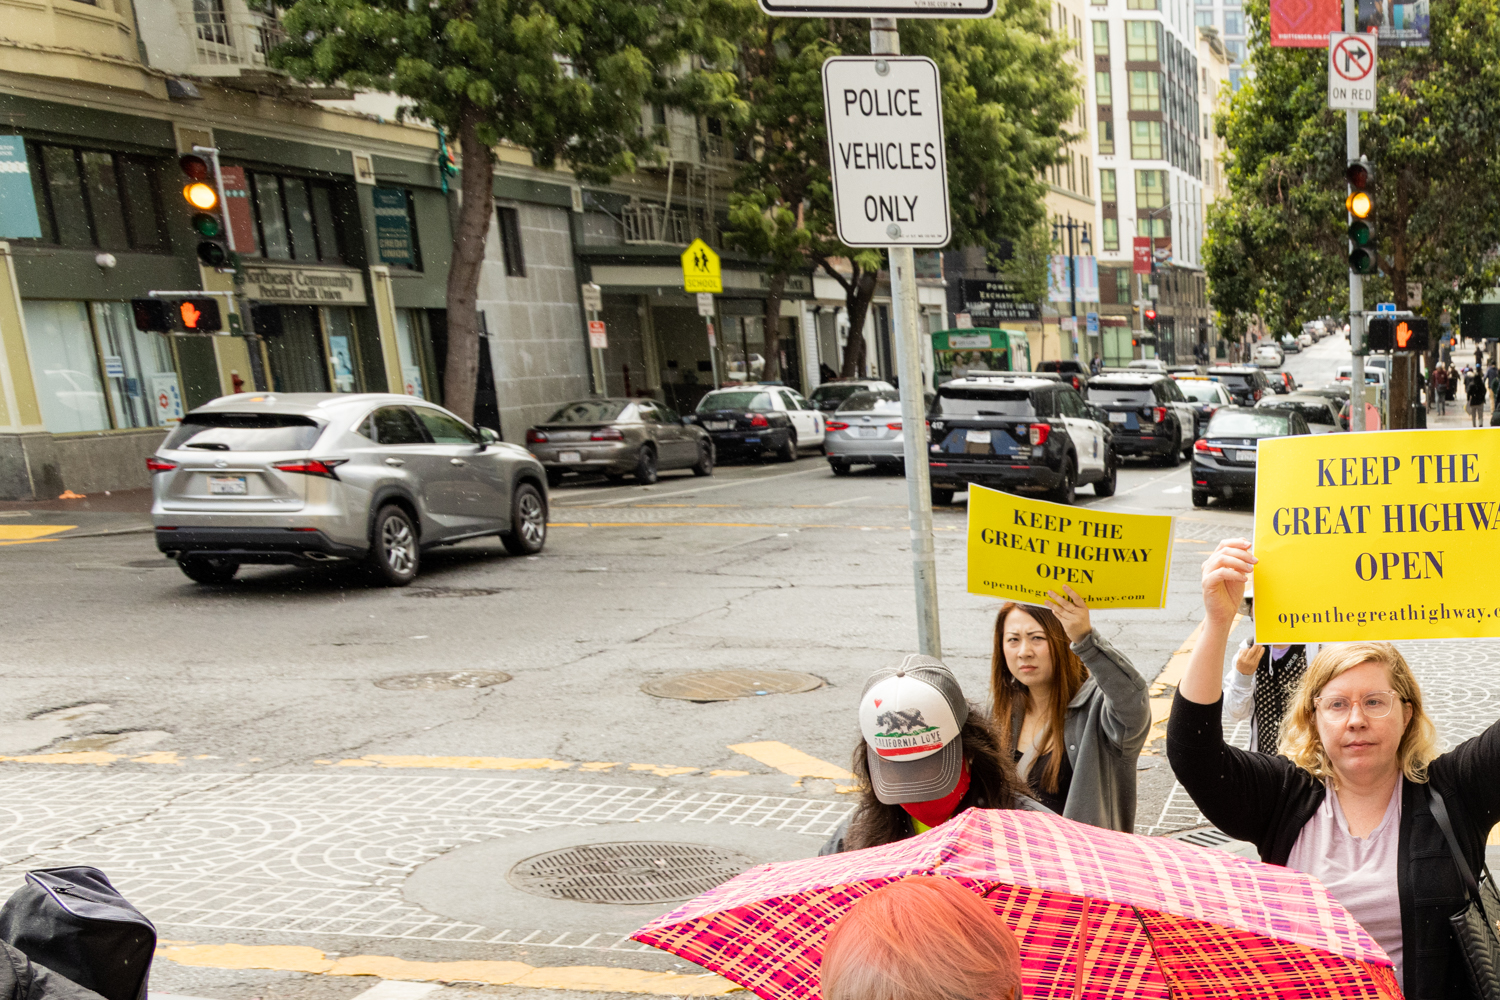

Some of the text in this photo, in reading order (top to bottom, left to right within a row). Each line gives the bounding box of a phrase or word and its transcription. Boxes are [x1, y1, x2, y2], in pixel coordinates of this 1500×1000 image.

[1278, 33, 1330, 41] VISITTENDERLOIN.CO
[843, 88, 922, 117] POLICE
[1332, 87, 1372, 101] ON RED
[838, 142, 937, 170] VEHICLES
[864, 194, 919, 223] ONLY
[379, 239, 408, 249] CREDIT
[381, 249, 409, 259] UNION
[259, 285, 343, 300] Federal Credit Union
[295, 272, 353, 292] Community
[687, 277, 719, 289] SCHOOL
[979, 291, 1017, 300] EXCHAN
[992, 310, 1008, 318] OPEN
[1316, 453, 1481, 488] KEEP THE
[1013, 508, 1124, 540] KEEP THE
[1272, 504, 1371, 537] GREAT
[981, 527, 1153, 563] GREAT HIGHWAY
[1036, 562, 1096, 585] OPEN
[1355, 550, 1445, 582] OPEN
[983, 578, 1146, 604] openthegrhway.com
[874, 730, 942, 749] CALIFORNIA LOVE
